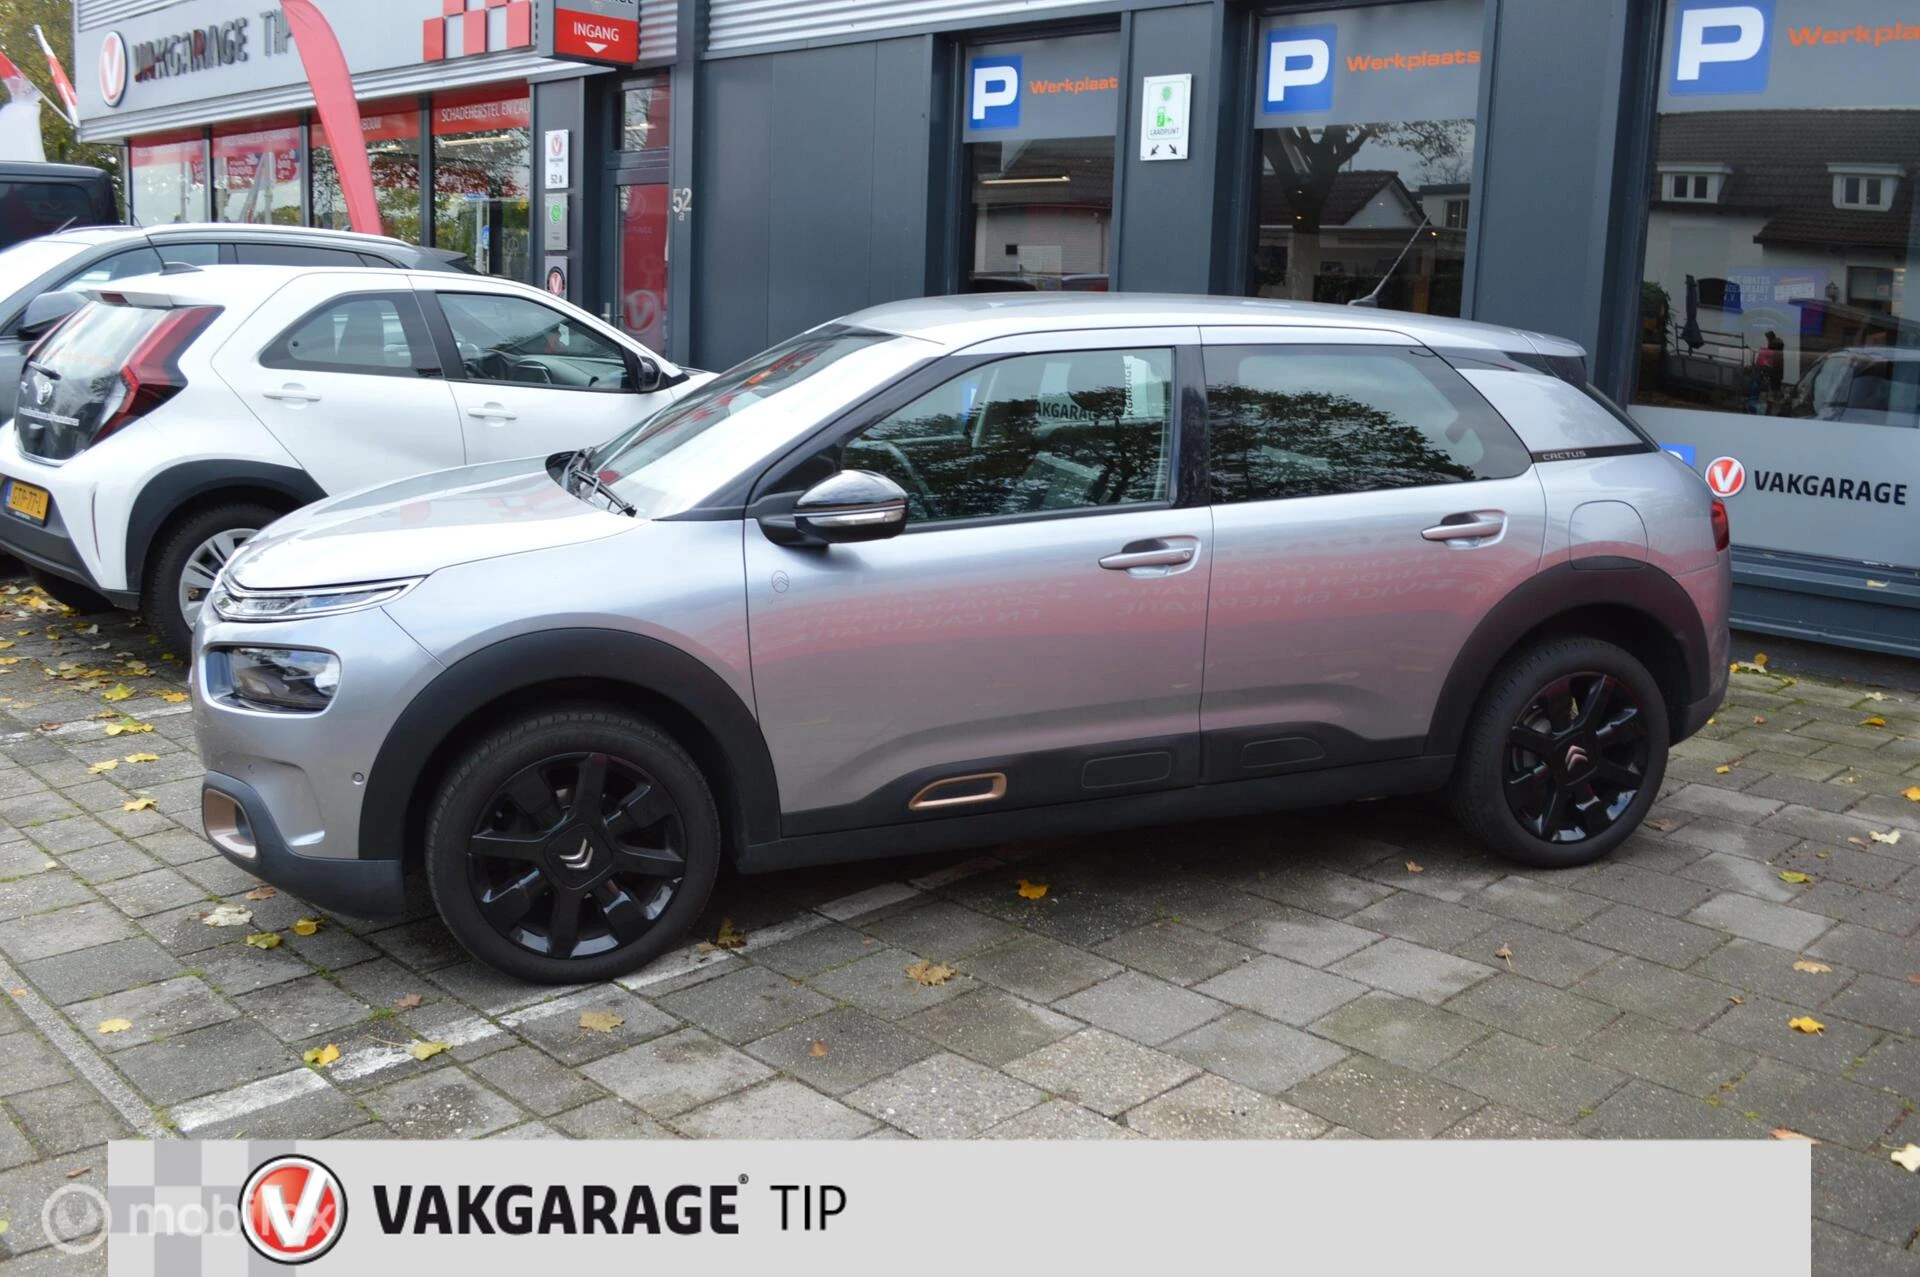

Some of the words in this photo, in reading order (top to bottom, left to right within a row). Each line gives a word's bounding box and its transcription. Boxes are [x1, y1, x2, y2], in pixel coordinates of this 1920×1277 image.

[573, 21, 620, 42] INGANG
[1676, 5, 1765, 81] P
[132, 17, 249, 83] VAKGARAGE
[1267, 38, 1330, 102] P
[1346, 49, 1481, 73] Werkplaats
[972, 65, 1019, 120] P
[441, 103, 500, 122] SCHADEHERSTEL
[1150, 127, 1180, 137] LAADPUNT
[672, 187, 692, 213] 52
[1541, 448, 1587, 461] CACTUS
[1754, 469, 1908, 506] VAKGARAGE
